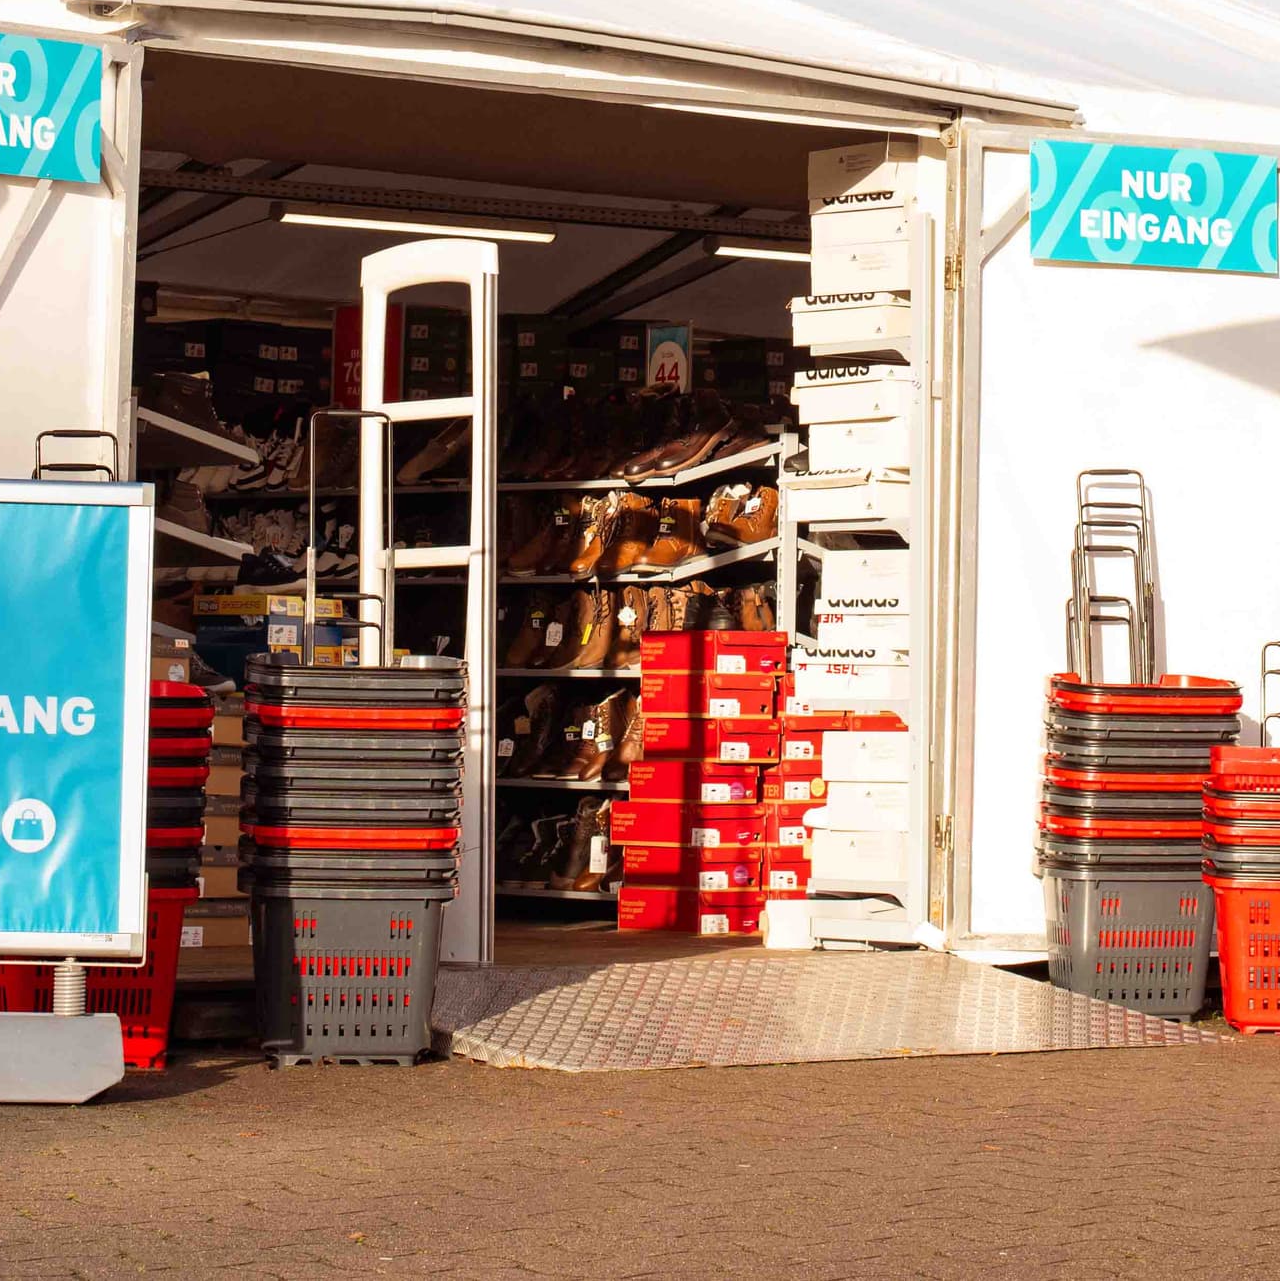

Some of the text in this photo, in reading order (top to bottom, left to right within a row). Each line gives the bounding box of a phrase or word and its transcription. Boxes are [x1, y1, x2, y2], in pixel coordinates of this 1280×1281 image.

[1121, 170, 1193, 203] NUR
[1080, 209, 1233, 249] EINGANG
[655, 362, 680, 383] 44
[763, 784, 780, 797] TER
